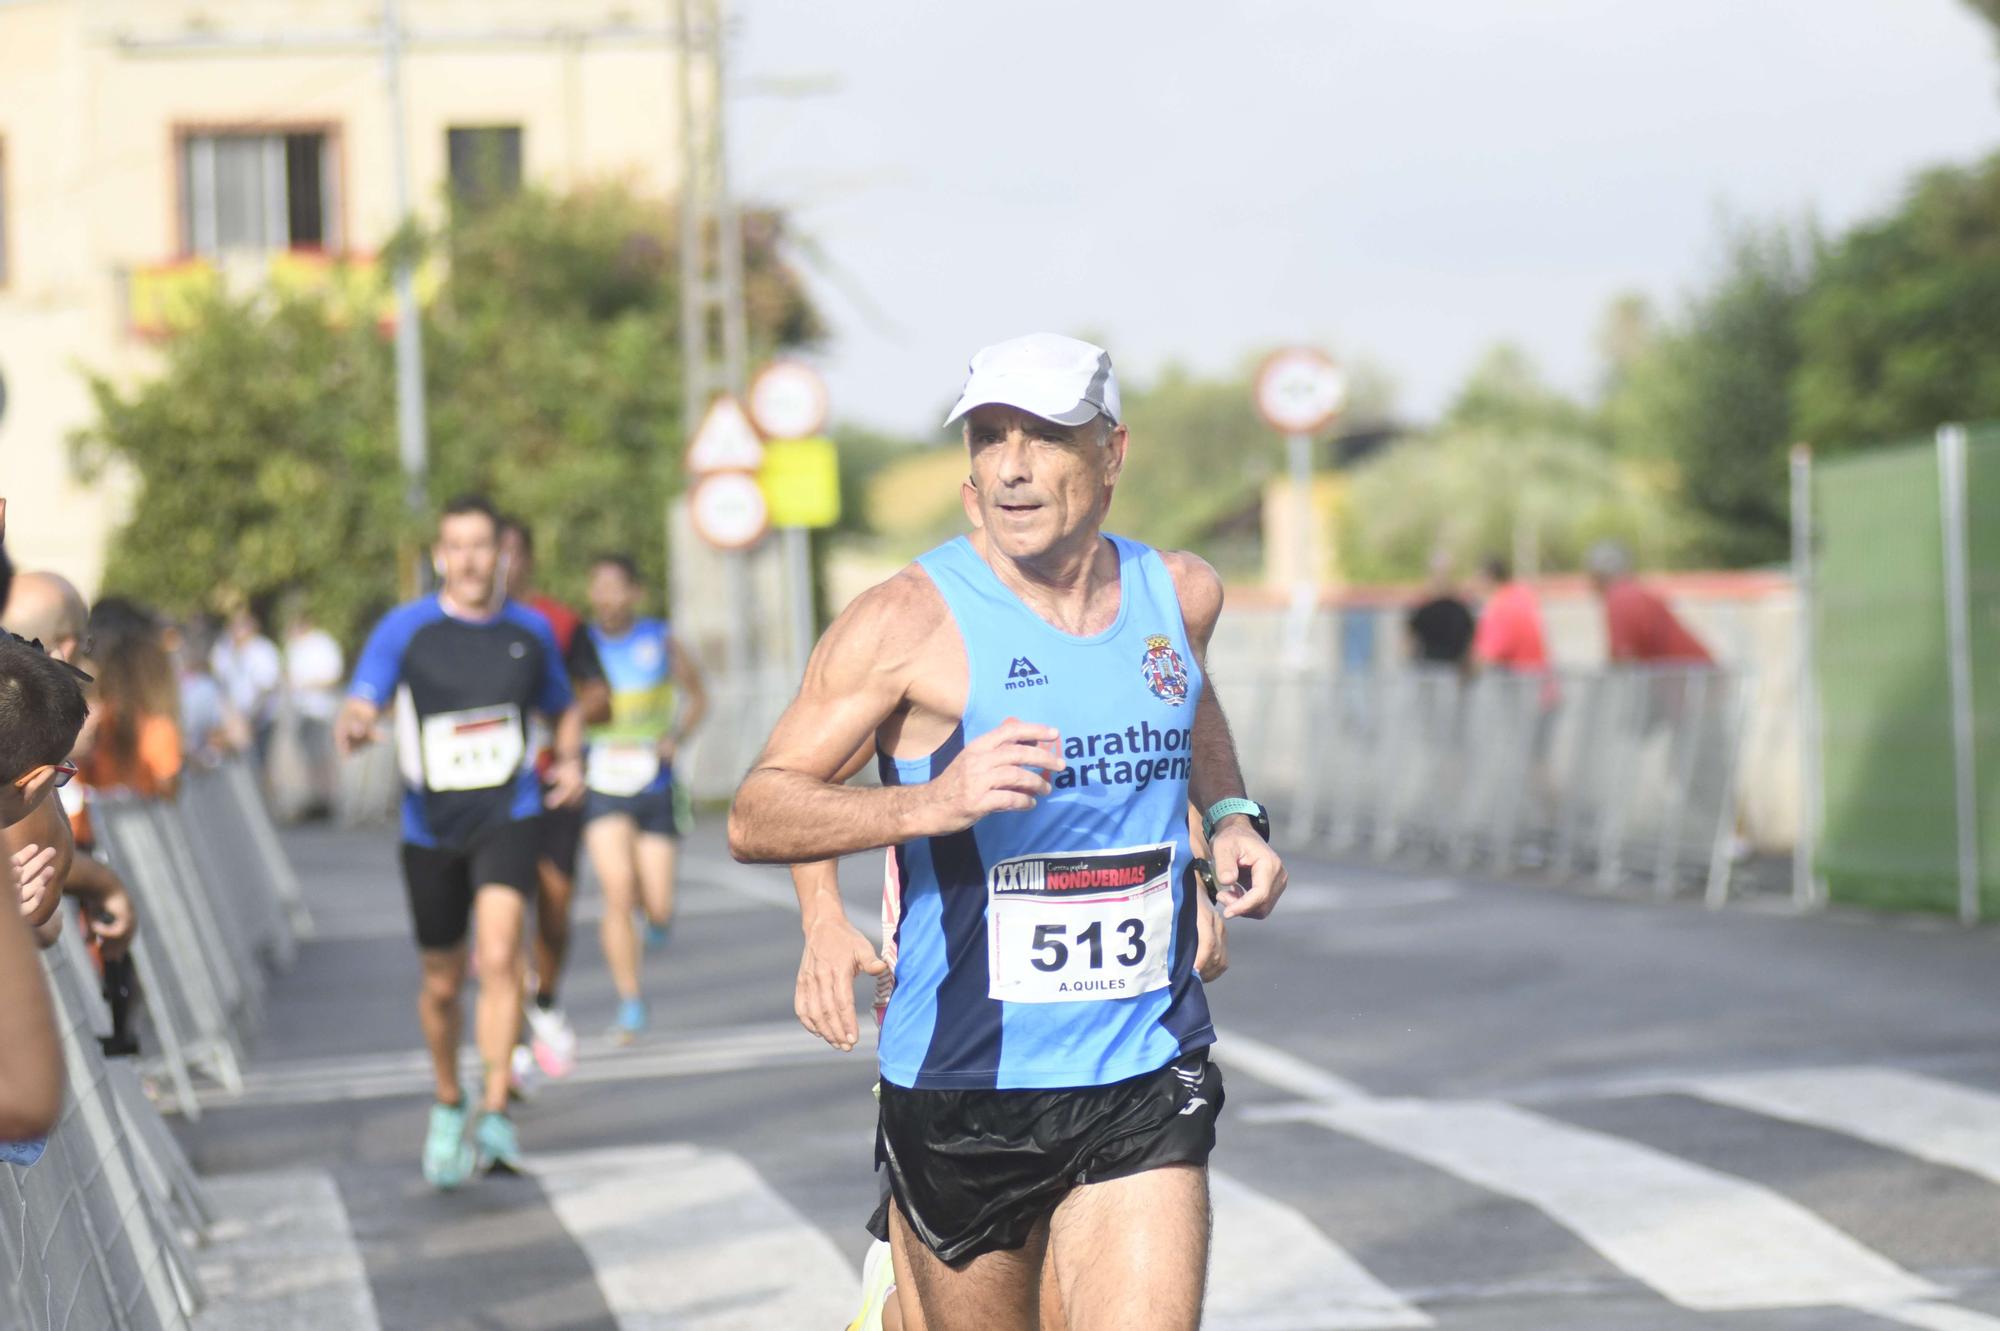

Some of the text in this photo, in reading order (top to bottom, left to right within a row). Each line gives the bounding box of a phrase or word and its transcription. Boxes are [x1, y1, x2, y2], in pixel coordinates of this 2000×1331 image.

[1004, 675, 1049, 690] mobel
[996, 861, 1146, 892] XXVIII NONDUERMAS
[1030, 918, 1147, 973] 513
[1058, 978, 1126, 993] A.QUILES
